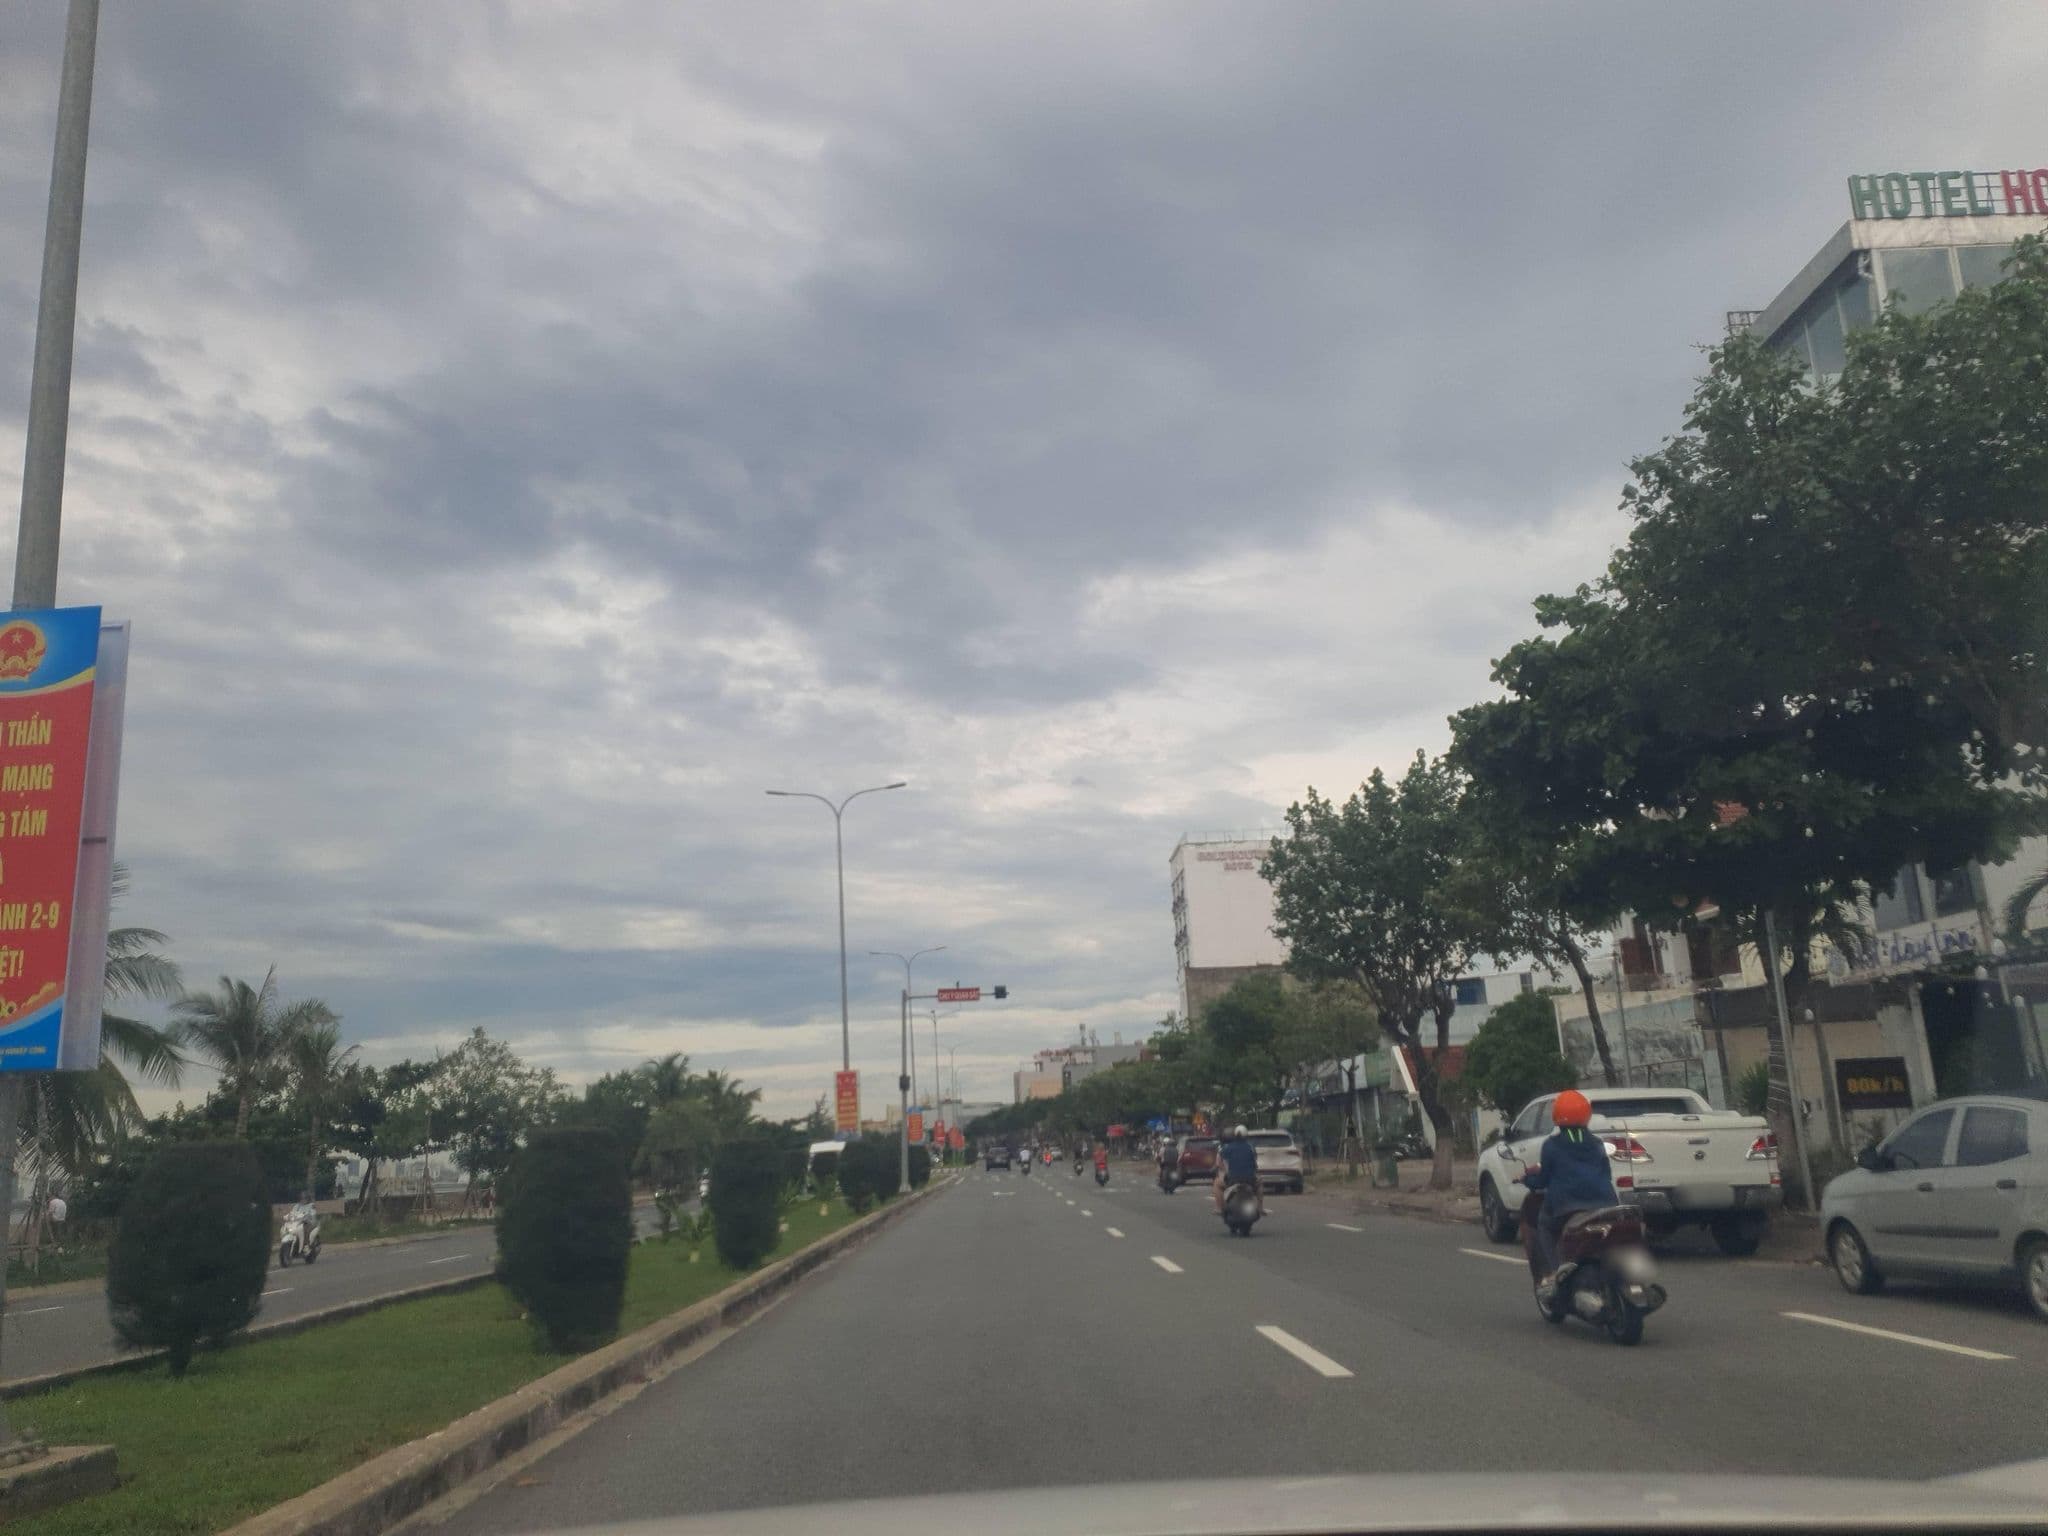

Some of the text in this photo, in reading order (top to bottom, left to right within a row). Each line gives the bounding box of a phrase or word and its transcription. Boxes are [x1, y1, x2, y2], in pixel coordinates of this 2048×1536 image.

[1848, 170, 1994, 220] HOTEL
[2, 763, 54, 797] MẠNG
[11, 804, 48, 837] TÁM
[30, 901, 60, 929] 2-9
